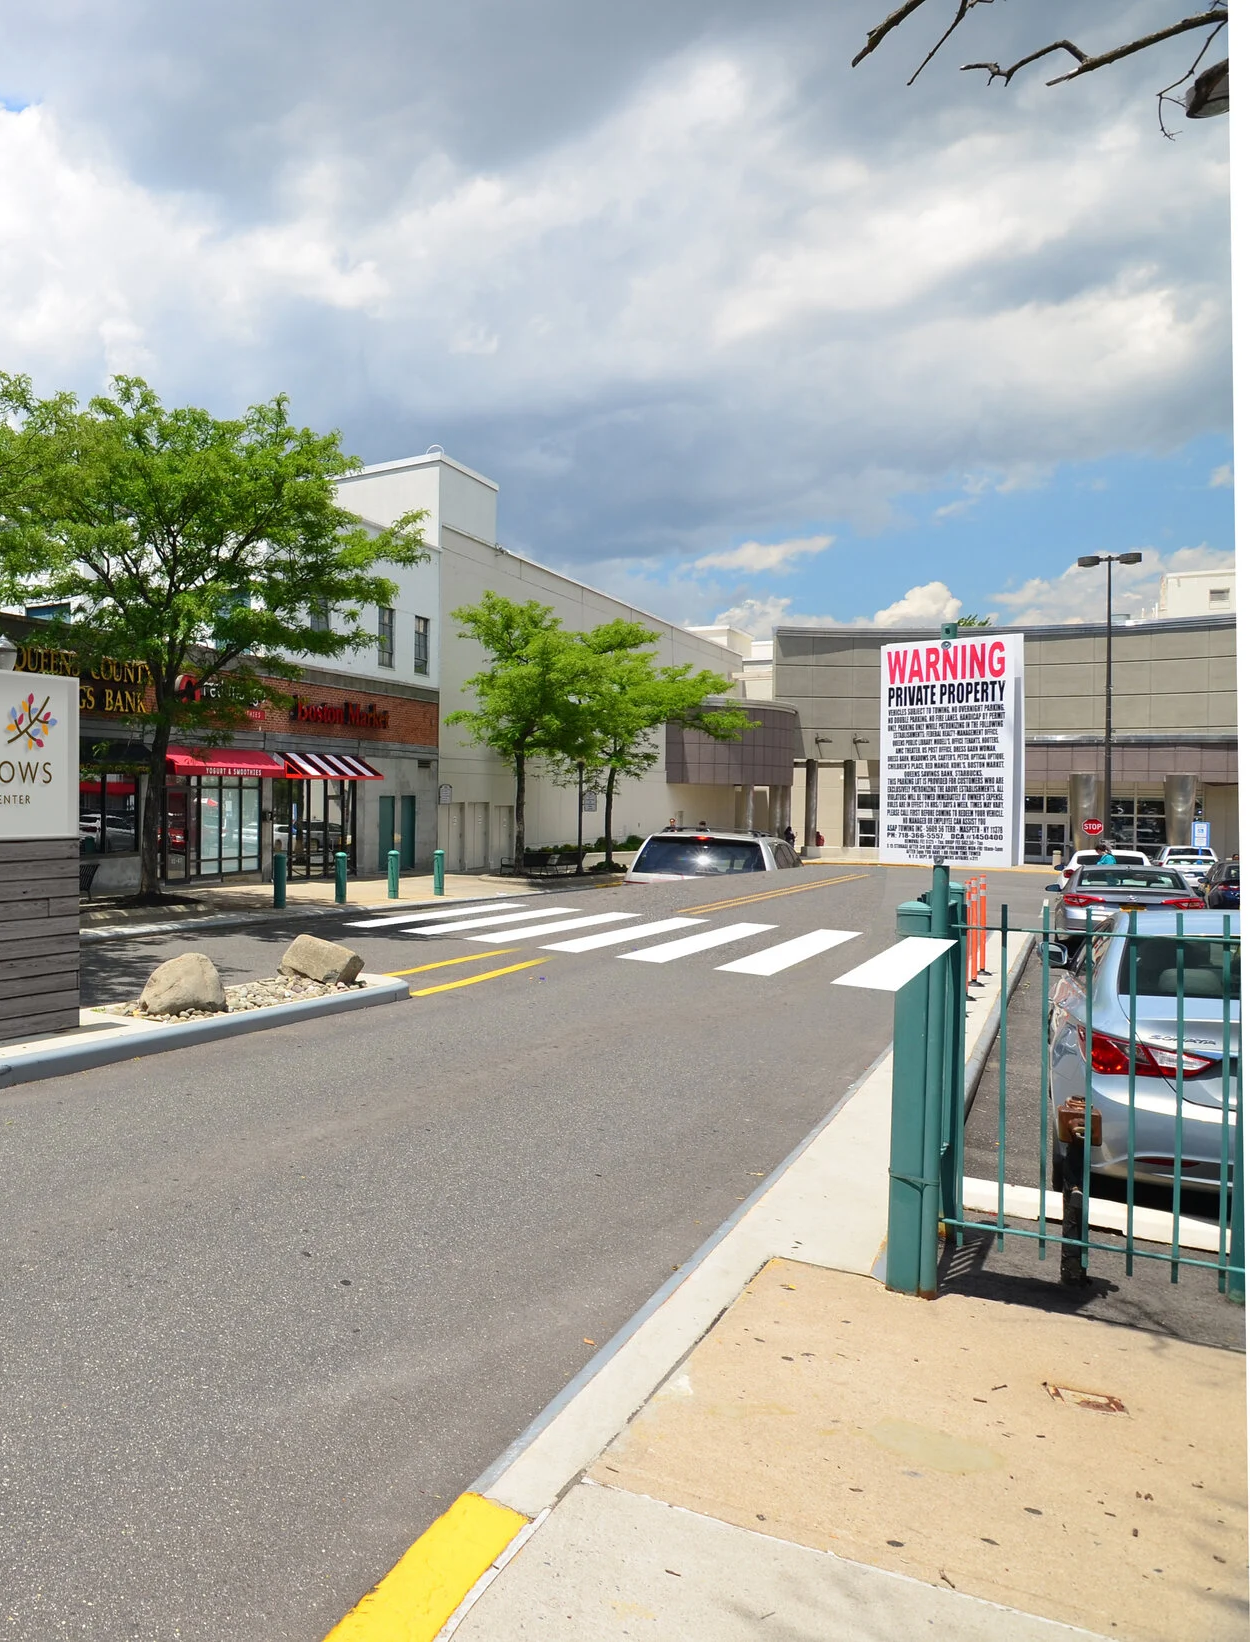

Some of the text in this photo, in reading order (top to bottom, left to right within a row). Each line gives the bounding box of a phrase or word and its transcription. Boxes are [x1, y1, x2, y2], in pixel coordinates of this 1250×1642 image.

[887, 642, 1006, 684] WARNING
[105, 688, 148, 713] BANK
[888, 680, 1006, 707] PRIVATE PROPERTY
[348, 702, 390, 728] Market
[206, 767, 227, 775] YOGURT
[233, 768, 262, 776] SMOOTHIES
[1148, 1034, 1216, 1046] SOATA
